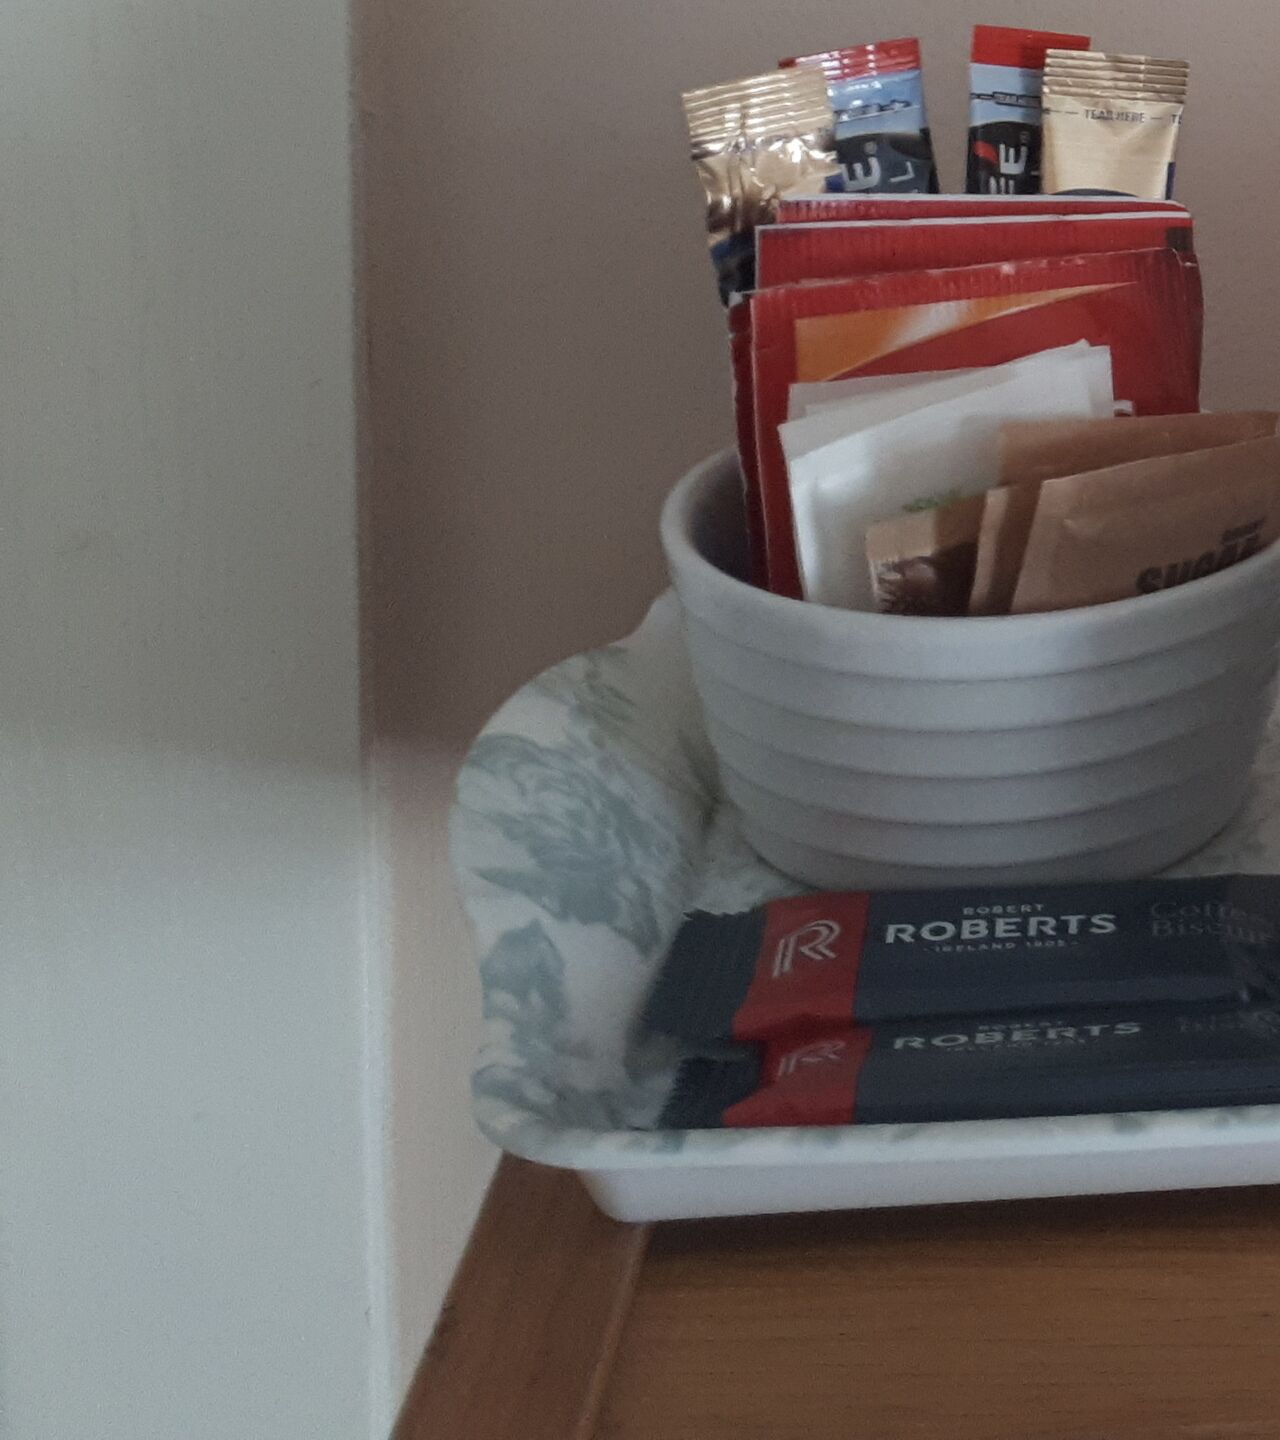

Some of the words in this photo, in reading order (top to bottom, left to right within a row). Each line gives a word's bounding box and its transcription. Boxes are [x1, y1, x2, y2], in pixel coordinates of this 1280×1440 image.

[962, 902, 1046, 916] ROBERT
[884, 912, 1118, 945] ROBERTS
[892, 1021, 1142, 1051] ROBERTS
